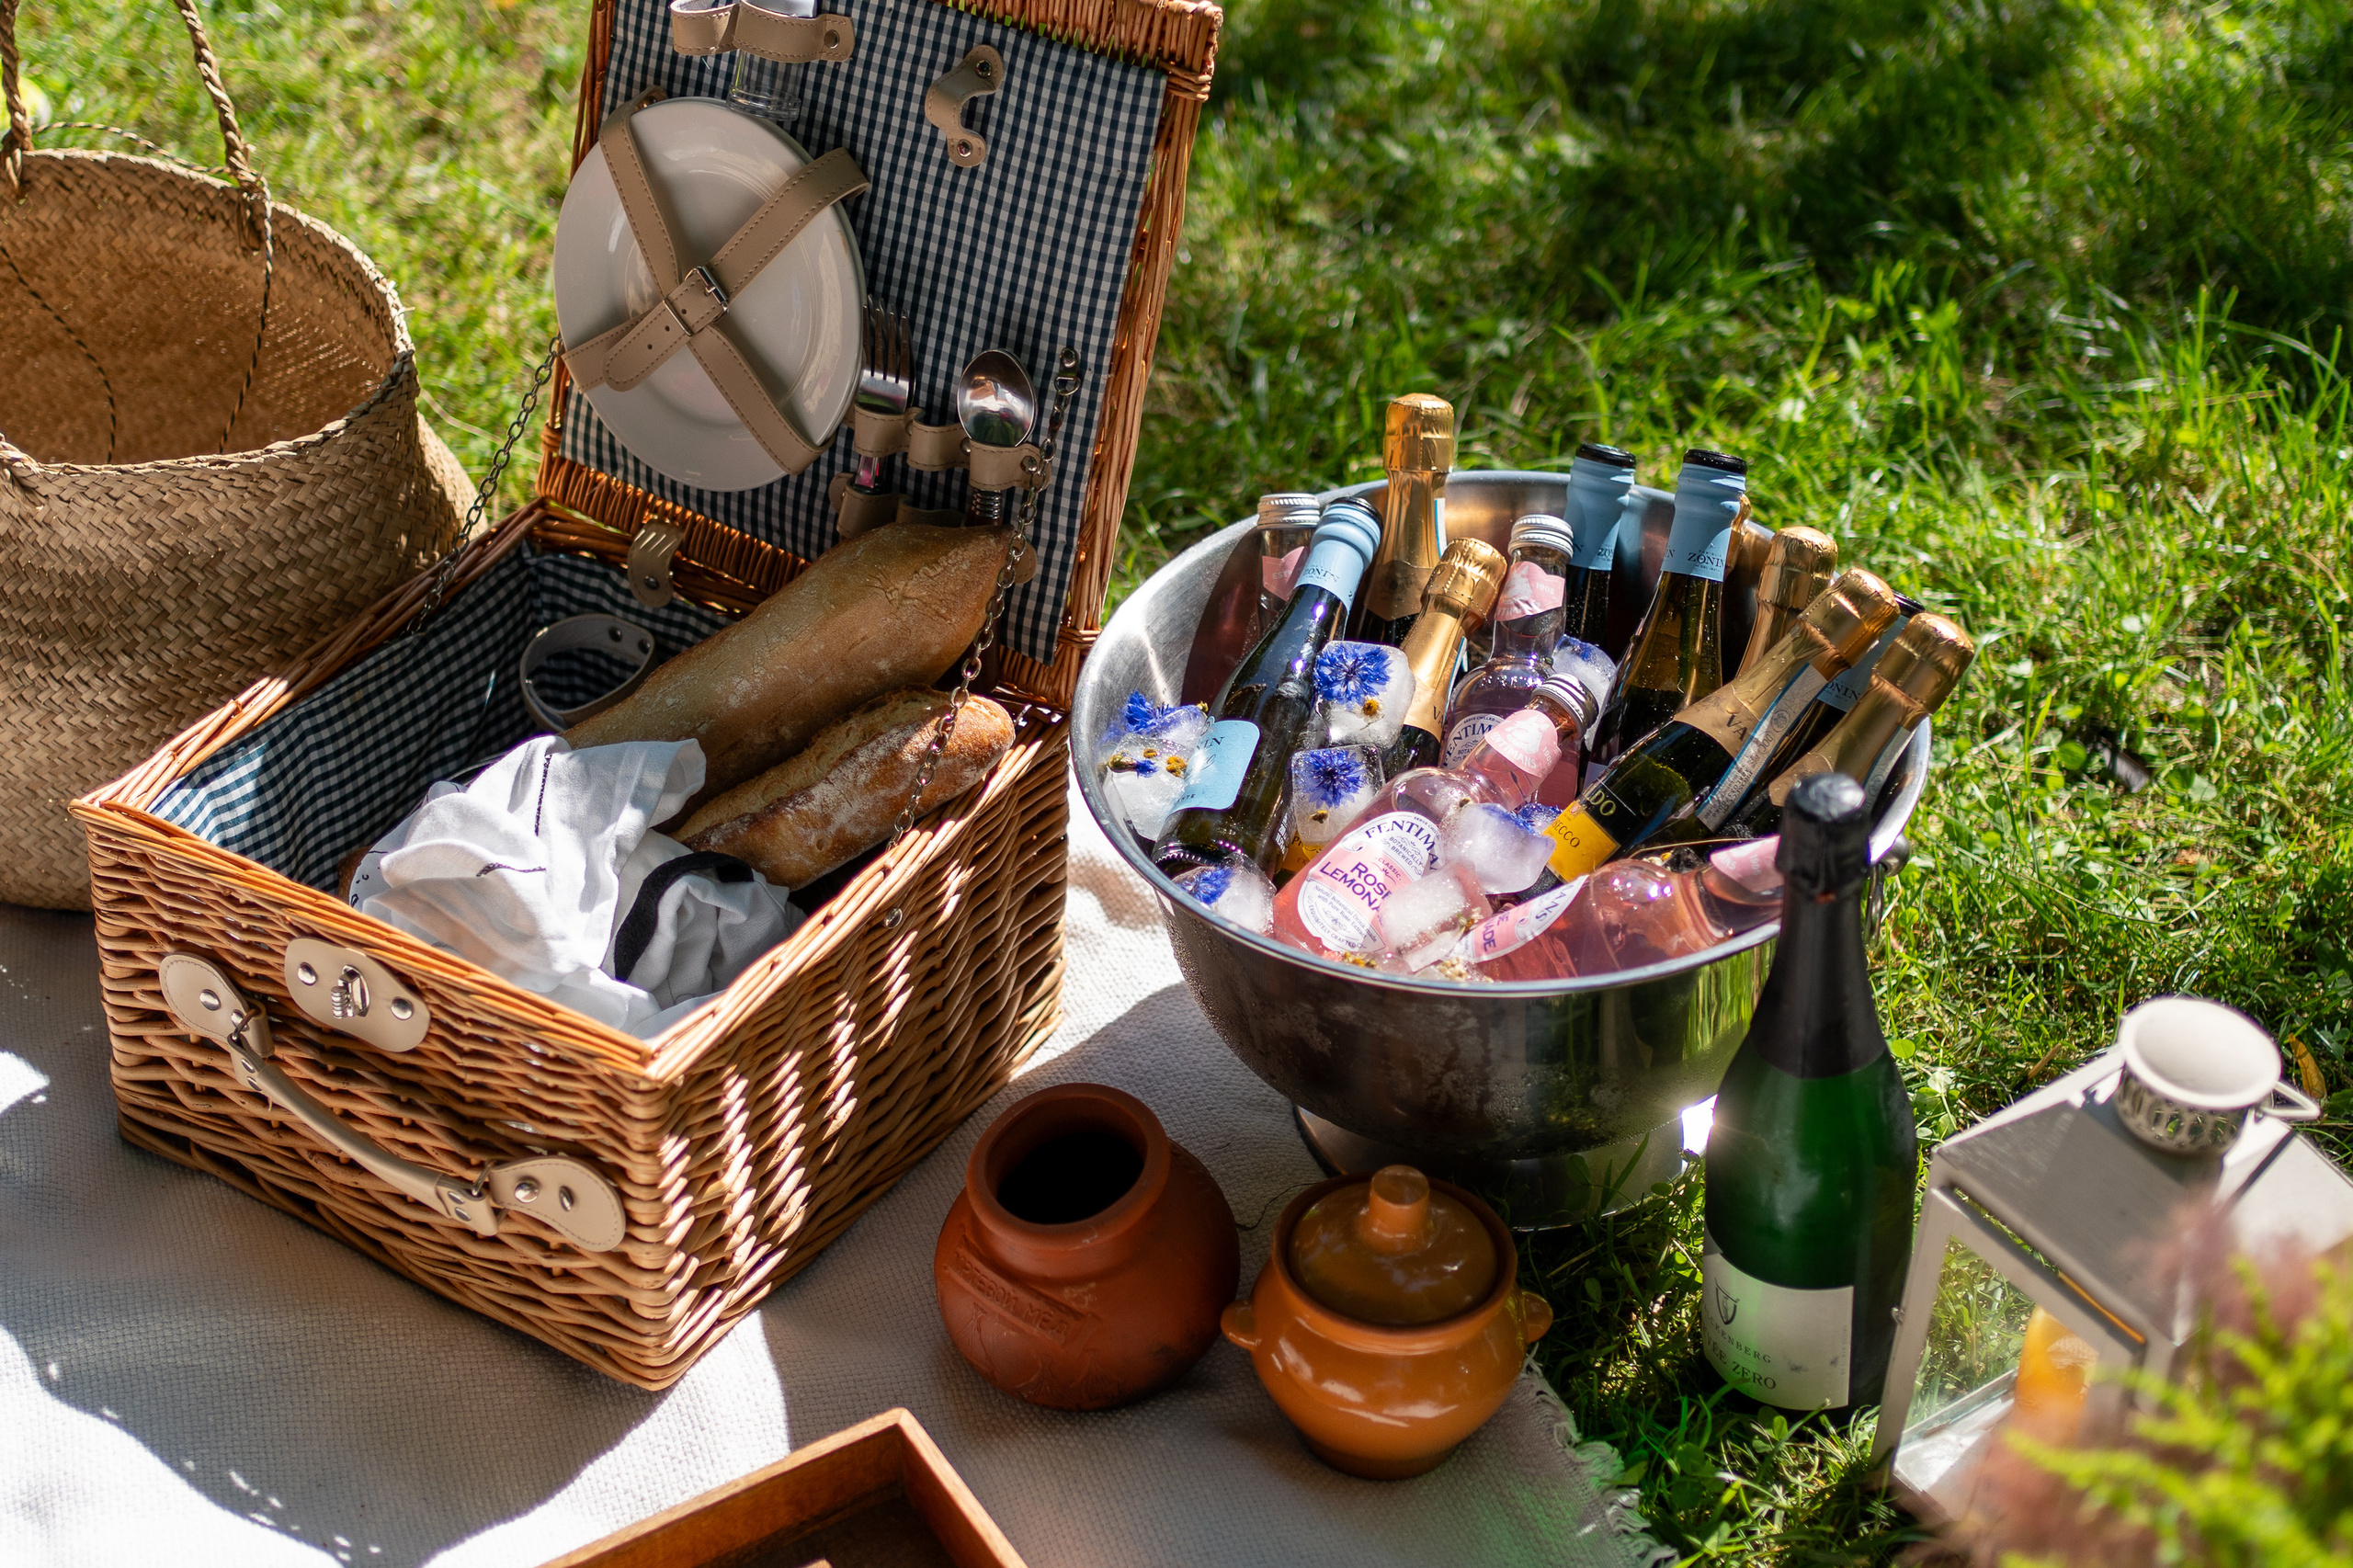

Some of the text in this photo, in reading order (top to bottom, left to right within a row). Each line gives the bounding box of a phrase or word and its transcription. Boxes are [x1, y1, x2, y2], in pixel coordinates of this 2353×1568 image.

[1827, 681, 1861, 701] ONIN
[1443, 722, 1493, 767] FENTIM
[1365, 820, 1439, 871] FENTIMA
[1552, 819, 1581, 848] SECCO
[1389, 835, 1424, 866] BOTANICALLY
[1391, 845, 1414, 866] BREWED
[1319, 861, 1381, 913] LEMON
[1313, 885, 1332, 898] Natural
[1332, 895, 1353, 916] Botanical
[1353, 913, 1366, 929] Drink
[1328, 901, 1340, 913] Pure
[1731, 1360, 1777, 1390] ZERO
